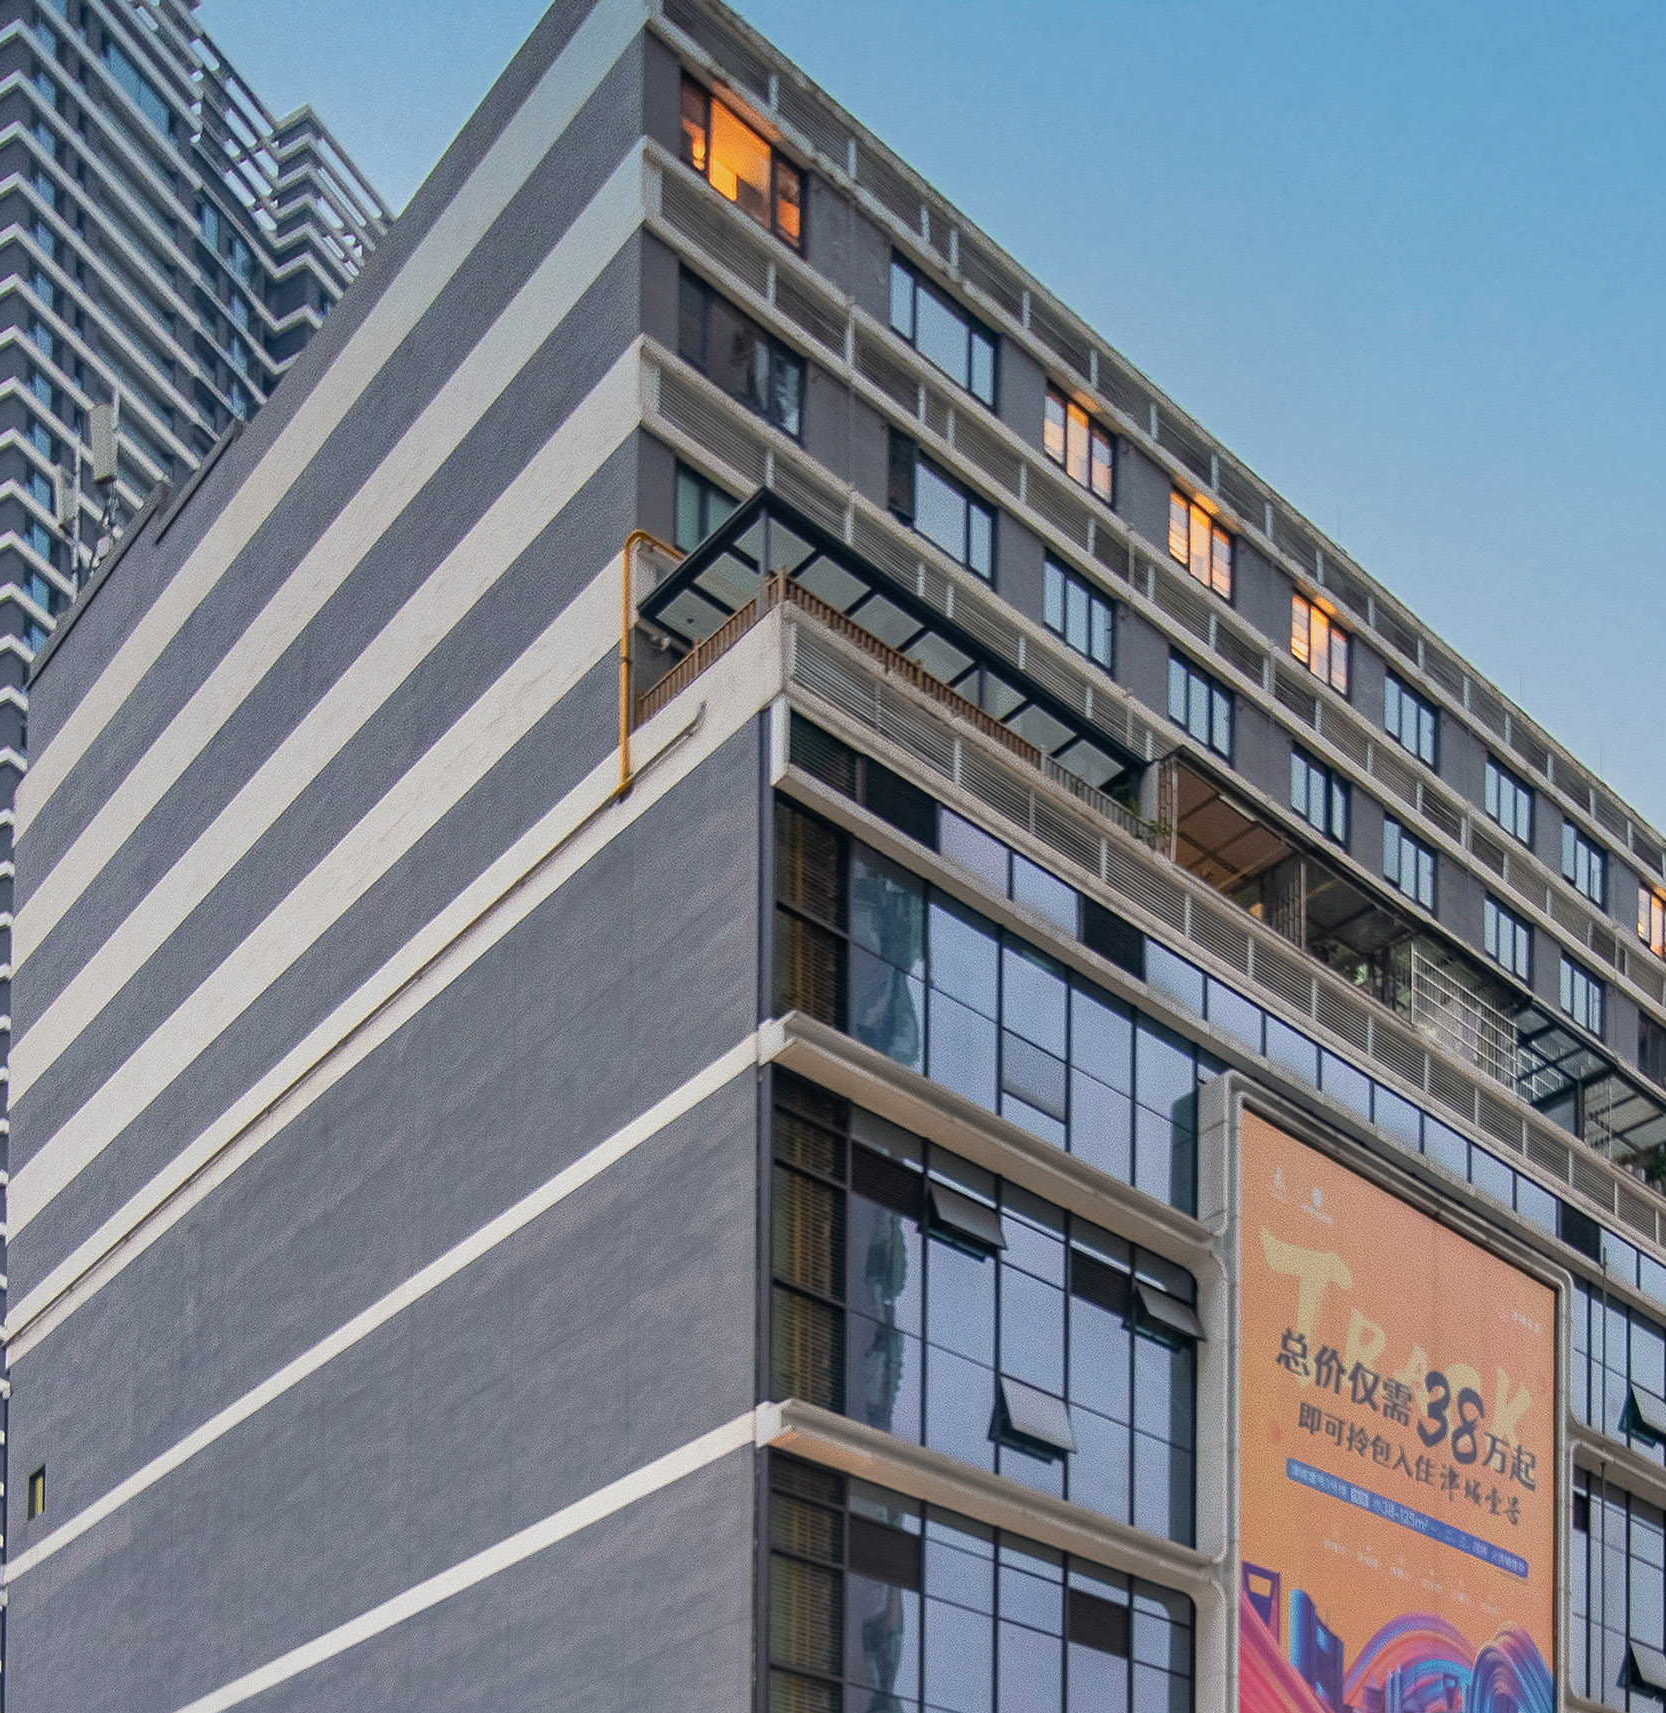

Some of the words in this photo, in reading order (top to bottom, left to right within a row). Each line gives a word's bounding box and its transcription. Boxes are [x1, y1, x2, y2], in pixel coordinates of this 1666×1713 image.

[1276, 1328, 1537, 1491] 总价仅需38万起
